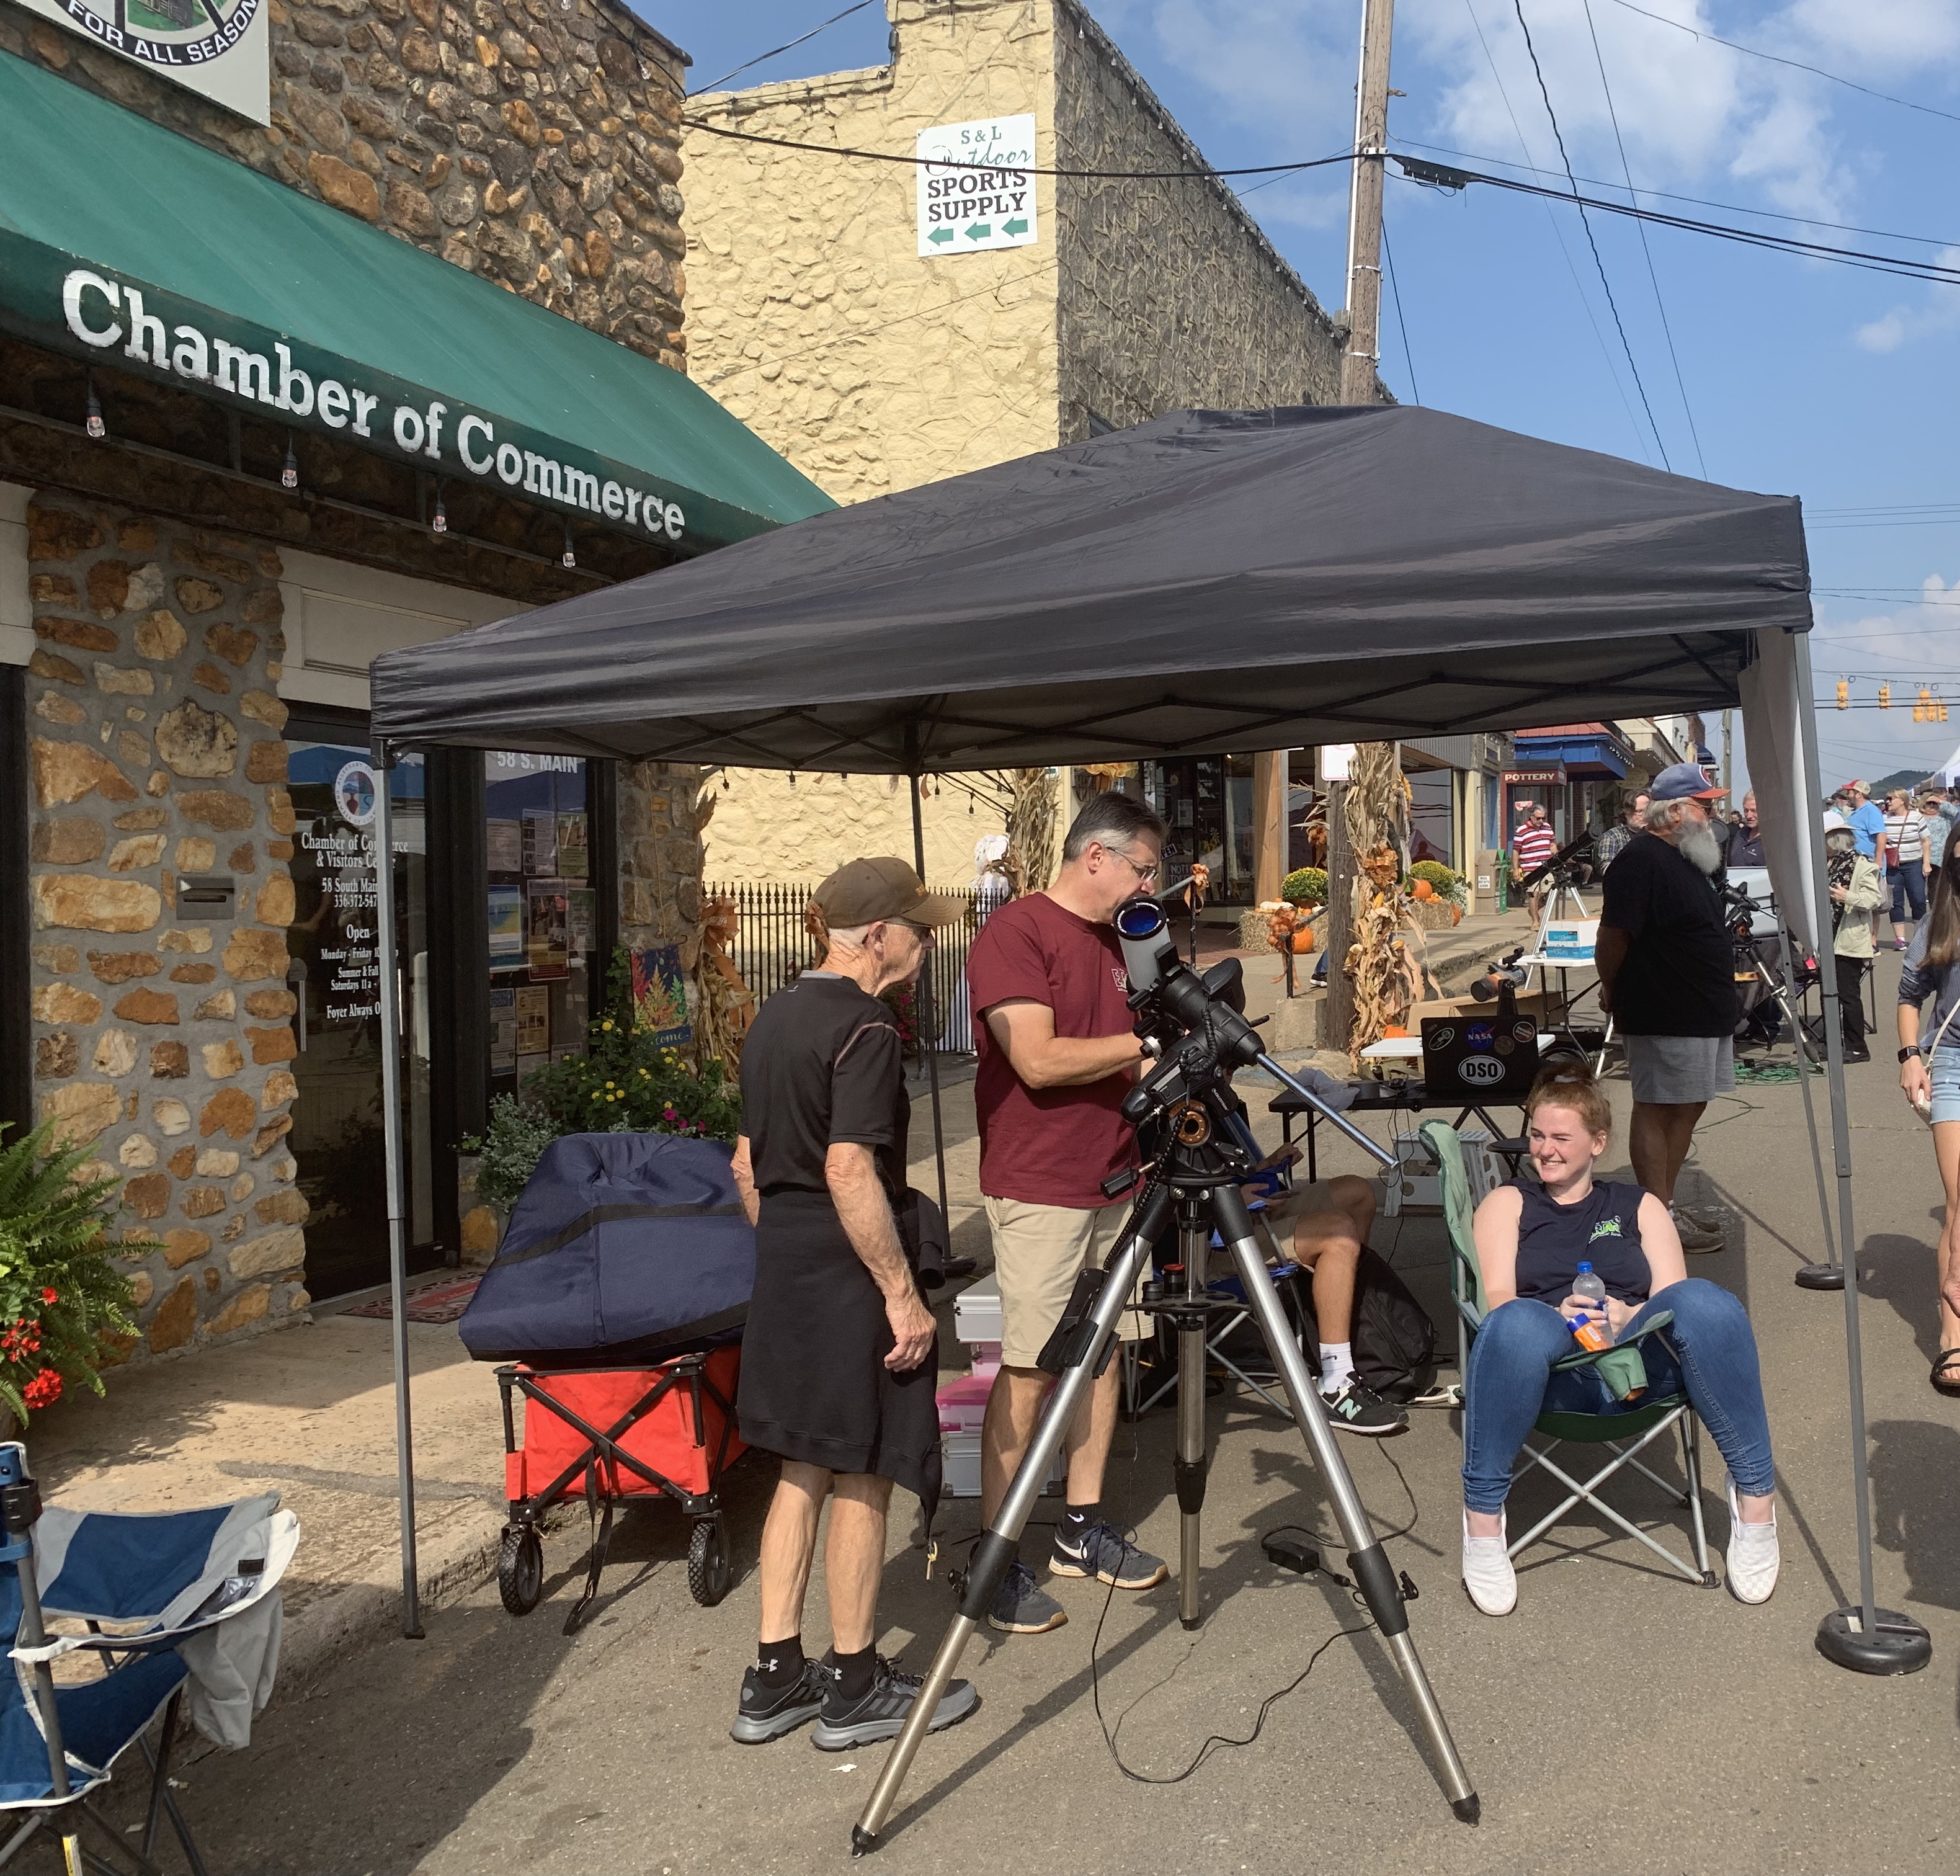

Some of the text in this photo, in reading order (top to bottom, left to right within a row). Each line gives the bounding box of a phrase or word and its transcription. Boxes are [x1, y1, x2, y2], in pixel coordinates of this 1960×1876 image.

[67, 0, 123, 48] FOR
[135, 40, 182, 63] ALL
[961, 126, 1002, 145] S & L
[925, 142, 1031, 176] Outdoor
[927, 171, 1027, 198] SPORTS
[928, 191, 1027, 222] SUPPLY
[63, 269, 685, 540] Chamber of Commerce
[540, 755, 577, 773] MAIN
[1505, 773, 1555, 781] POTTERY
[301, 832, 344, 850] Chamber
[348, 834, 359, 850] of
[316, 850, 324, 868] &
[326, 850, 363, 868] Visitors
[322, 878, 333, 893] 58
[335, 878, 359, 893] South
[346, 924, 370, 943] Open
[321, 948, 347, 962] Monday
[352, 947, 372, 962] Friday
[338, 967, 361, 978] Summer
[368, 965, 378, 976] Fall
[331, 979, 359, 993] Saturdays
[326, 1005, 347, 1022] Foyer
[349, 1003, 373, 1020] Always
[1466, 1063, 1498, 1077] DSO
